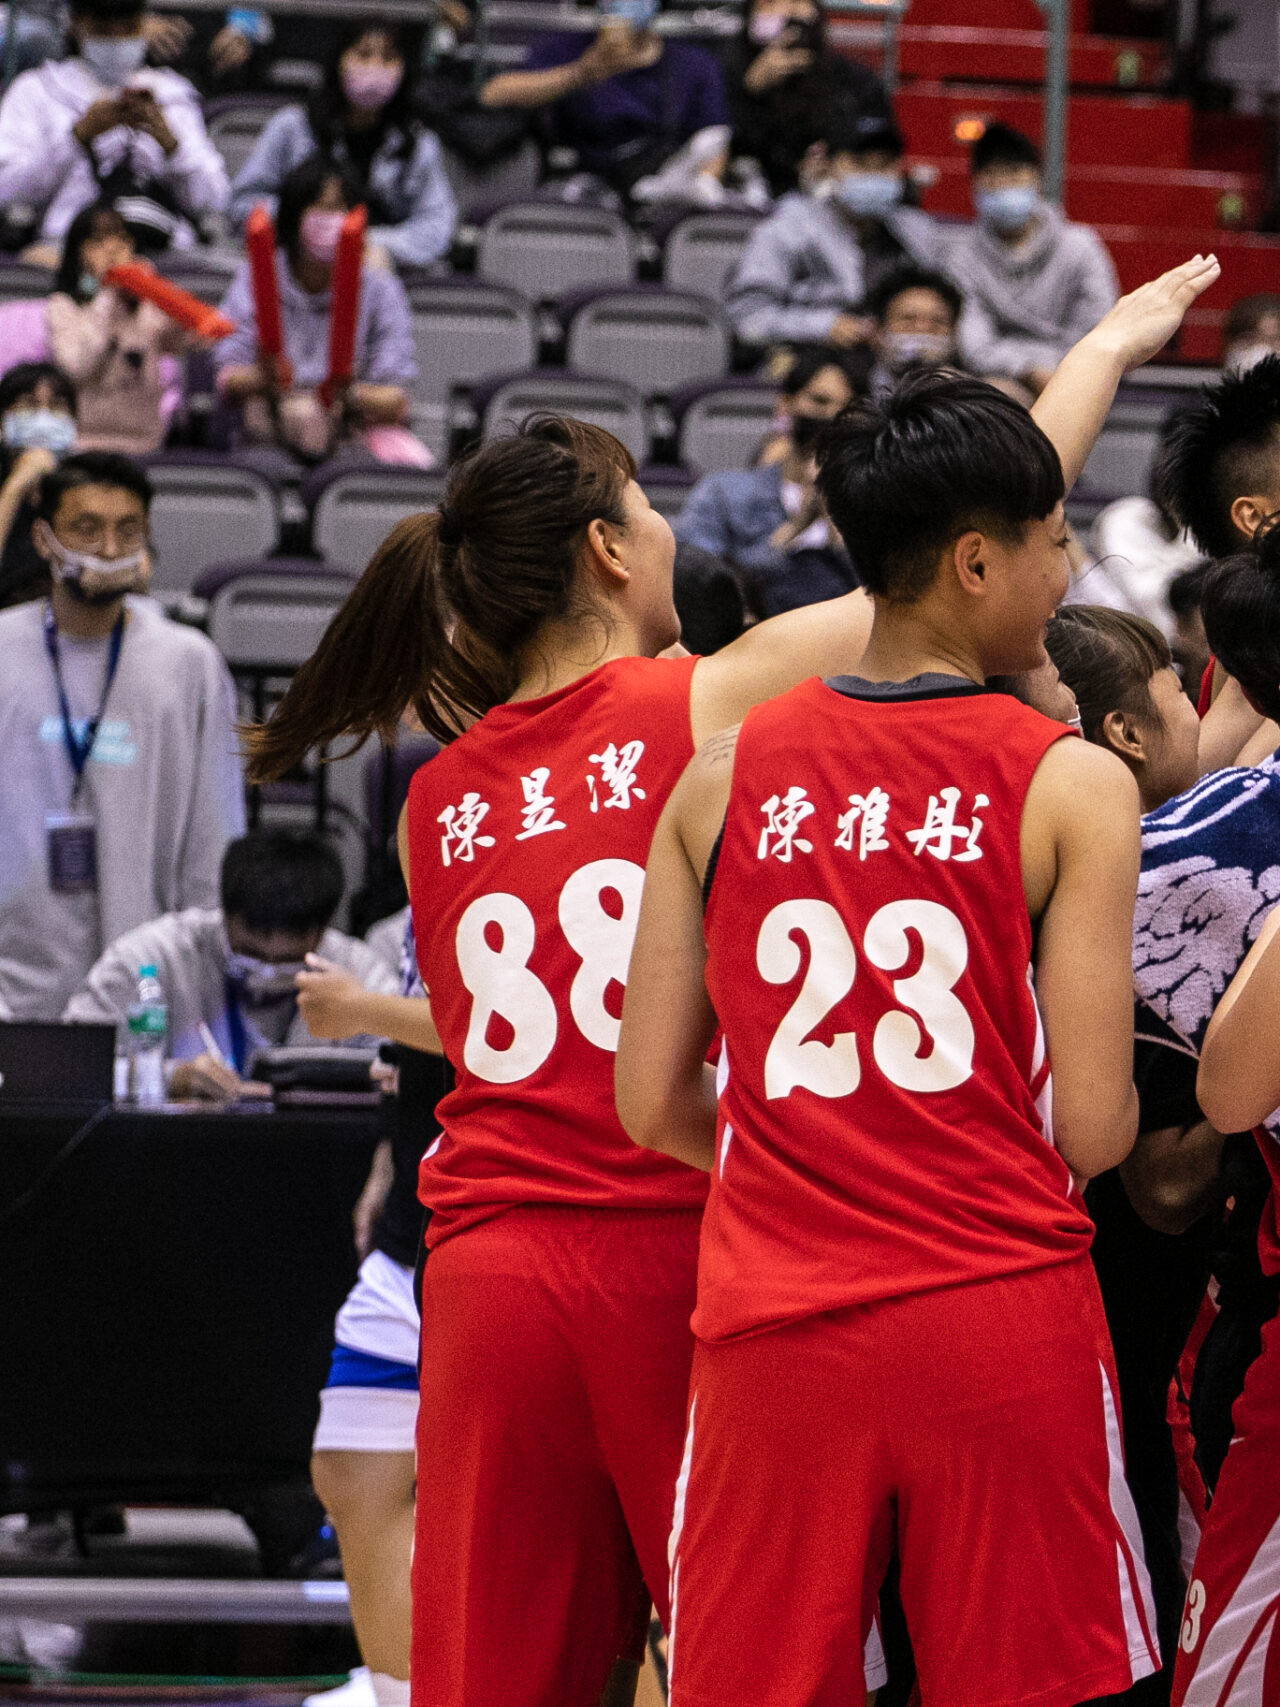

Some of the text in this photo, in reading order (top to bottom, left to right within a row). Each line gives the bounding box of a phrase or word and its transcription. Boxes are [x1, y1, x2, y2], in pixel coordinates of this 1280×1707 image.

[436, 740, 646, 867] 陳昱潔
[757, 786, 990, 863] 陳雅彤
[456, 858, 647, 1085] 88
[756, 898, 975, 1100] 23
[1179, 1577, 1206, 1654] 3
